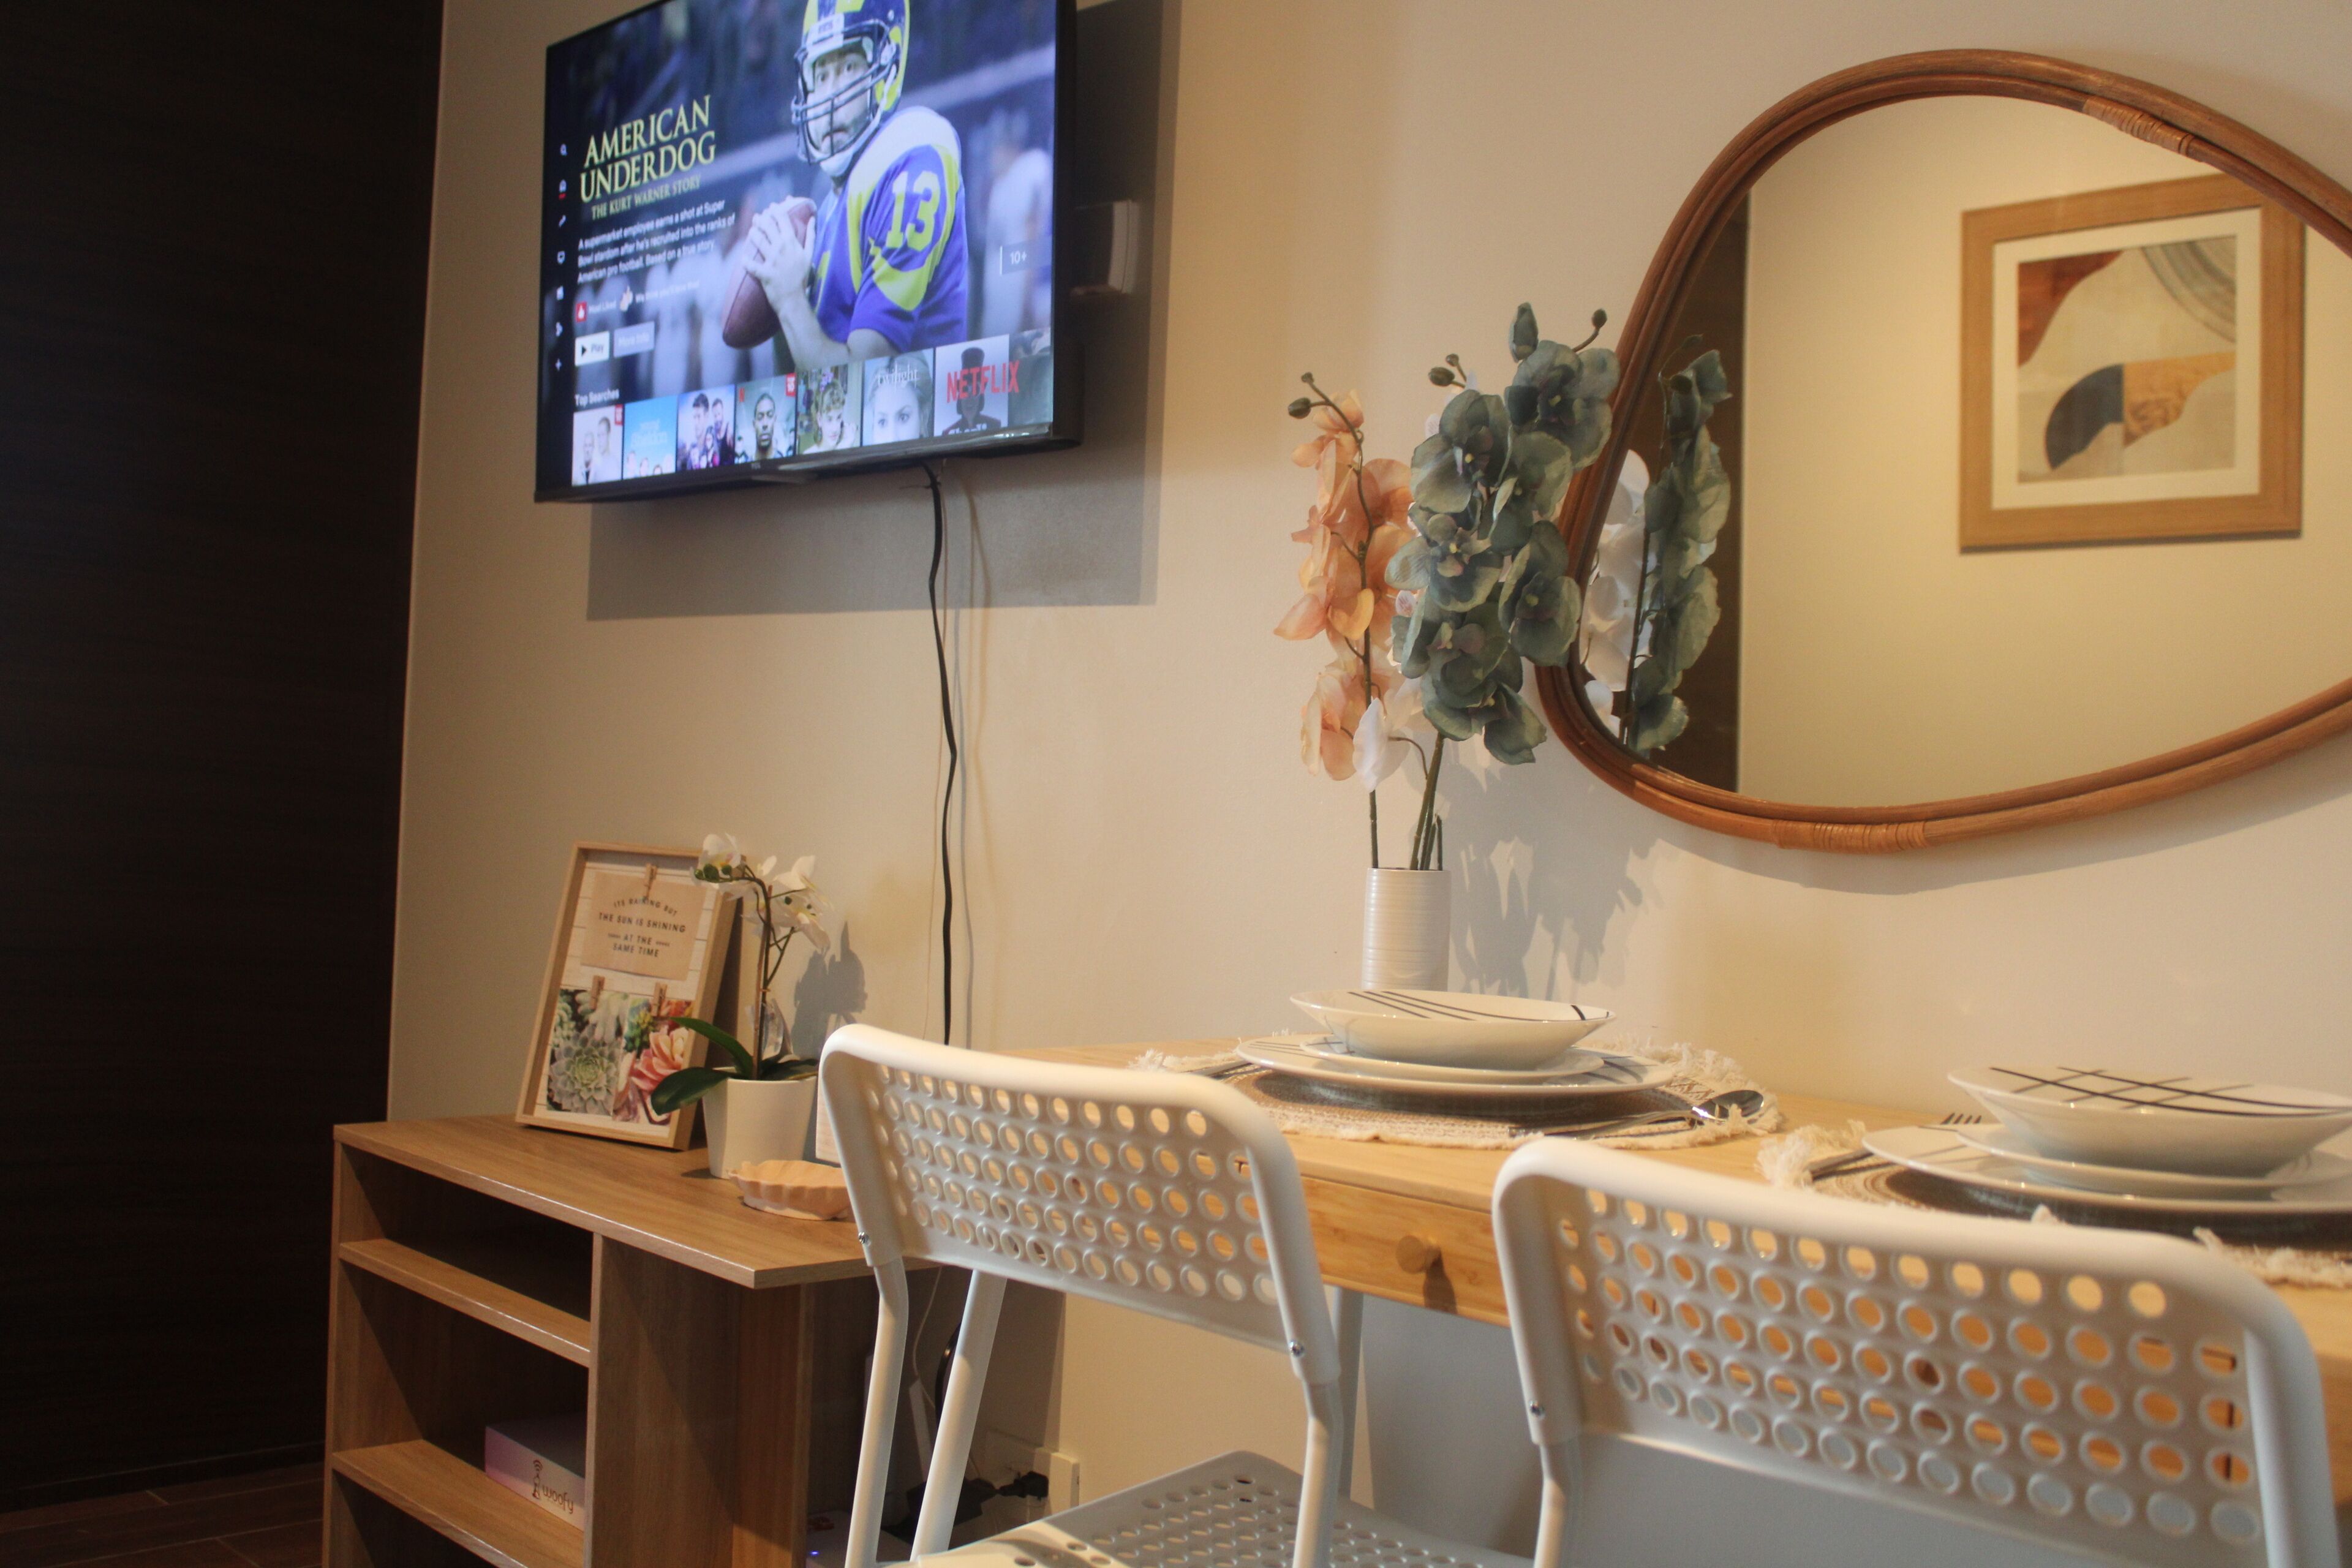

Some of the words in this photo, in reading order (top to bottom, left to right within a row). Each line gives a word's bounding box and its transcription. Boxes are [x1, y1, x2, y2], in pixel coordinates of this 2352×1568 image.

[584, 95, 710, 168] AMERICAN
[580, 130, 717, 203] UNDERDOG
[592, 202, 607, 221] THE
[609, 194, 631, 215] KURT
[634, 184, 670, 206] WARNER
[673, 174, 701, 195] STORY
[886, 171, 941, 252] 13
[578, 239, 584, 251] A
[623, 220, 655, 240] employee
[680, 207, 695, 222] shot
[696, 204, 704, 217] at
[704, 200, 725, 216] Super
[578, 252, 594, 268] Bowl
[620, 242, 635, 260] after
[650, 228, 680, 247] recruited
[680, 225, 694, 239] into
[695, 222, 706, 236] the
[707, 216, 726, 232] ranks
[727, 212, 735, 227] of
[578, 266, 607, 285] American
[608, 264, 618, 277] pro
[646, 250, 666, 267] Based
[667, 249, 676, 262] on
[682, 244, 696, 256] true
[1010, 251, 1027, 265] 10+
[590, 343, 604, 355] Play
[876, 361, 921, 389] twilight
[946, 360, 1020, 402] NETFLIX
[575, 393, 588, 407] Top
[589, 388, 619, 404] Searches
[599, 912, 613, 922] THE
[617, 915, 632, 924] SUN
[647, 920, 686, 933] SHINING
[664, 905, 678, 916] BUT
[613, 943, 634, 954] SAME
[638, 946, 659, 957] TIME
[637, 935, 652, 945] THE
[543, 1485, 573, 1514] woofy
